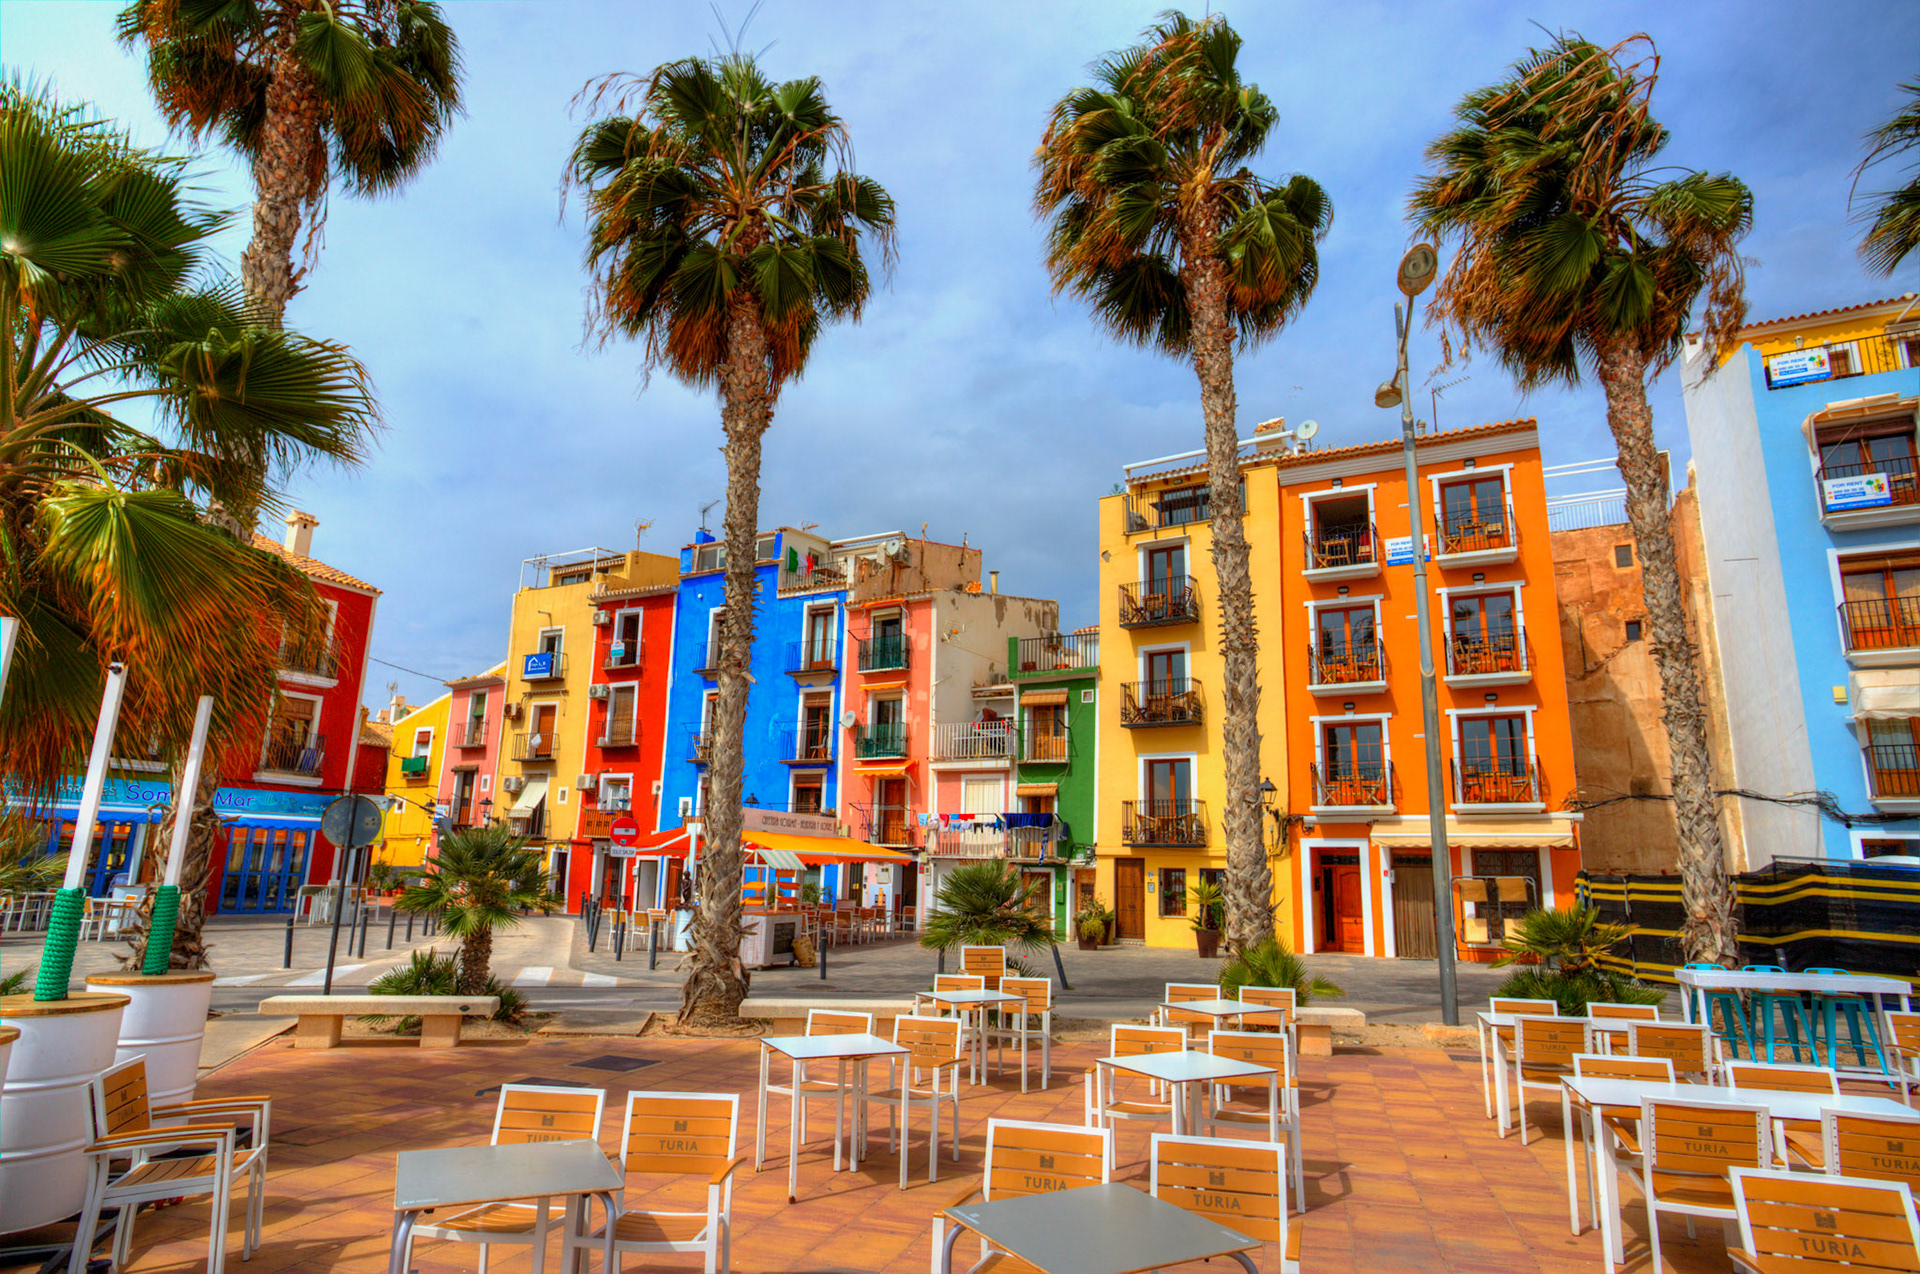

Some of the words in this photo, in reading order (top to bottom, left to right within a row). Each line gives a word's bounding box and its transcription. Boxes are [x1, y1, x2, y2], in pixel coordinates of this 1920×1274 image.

[1656, 1050, 1685, 1059] TURIA
[659, 1140, 698, 1151] TURIA
[1684, 1142, 1728, 1154] TURIA
[1871, 1157, 1920, 1170] TURIA
[1024, 1176, 1068, 1191] TURIA
[1193, 1193, 1241, 1210] TURIA
[1798, 1237, 1866, 1259] TURIA
